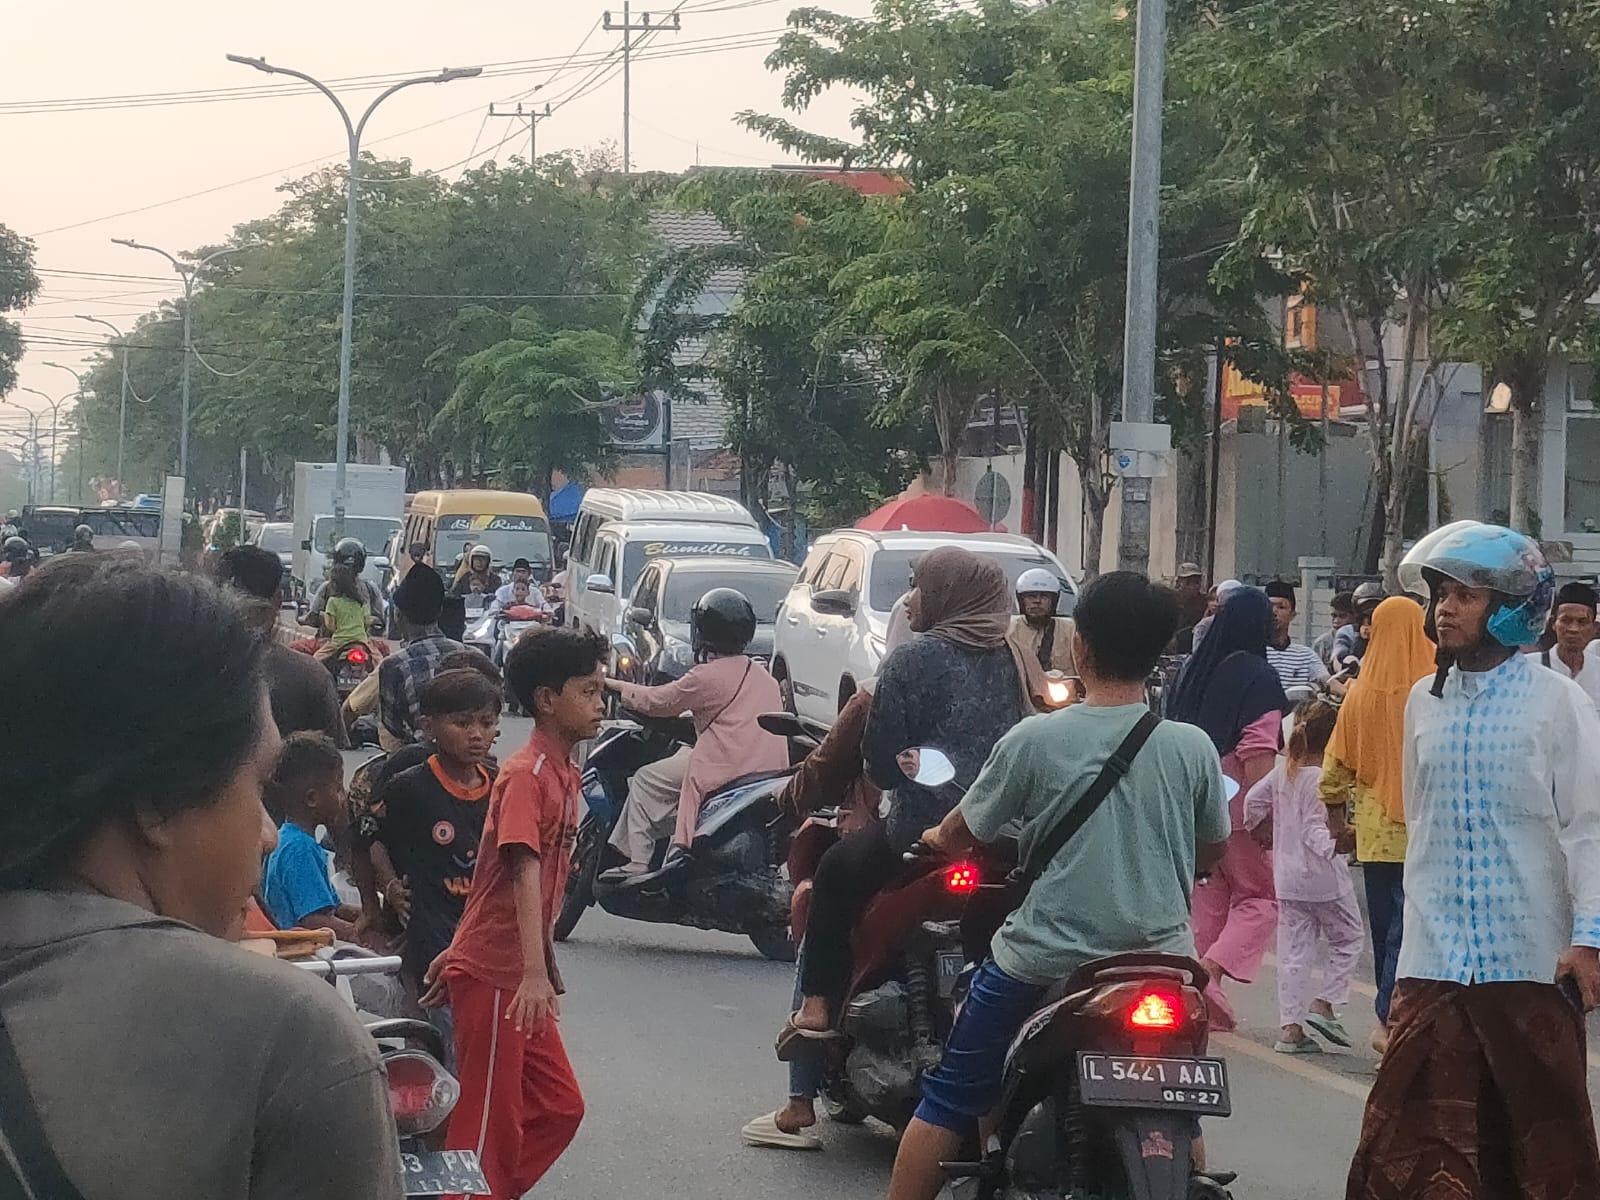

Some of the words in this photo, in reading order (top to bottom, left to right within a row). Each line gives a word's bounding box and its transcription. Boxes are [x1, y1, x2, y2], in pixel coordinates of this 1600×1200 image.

[643, 542, 752, 556] Bismillah
[1089, 1060, 1104, 1081] L
[1112, 1061, 1166, 1083] 5421
[1179, 1065, 1218, 1086] AAI
[441, 1152, 479, 1172] PW
